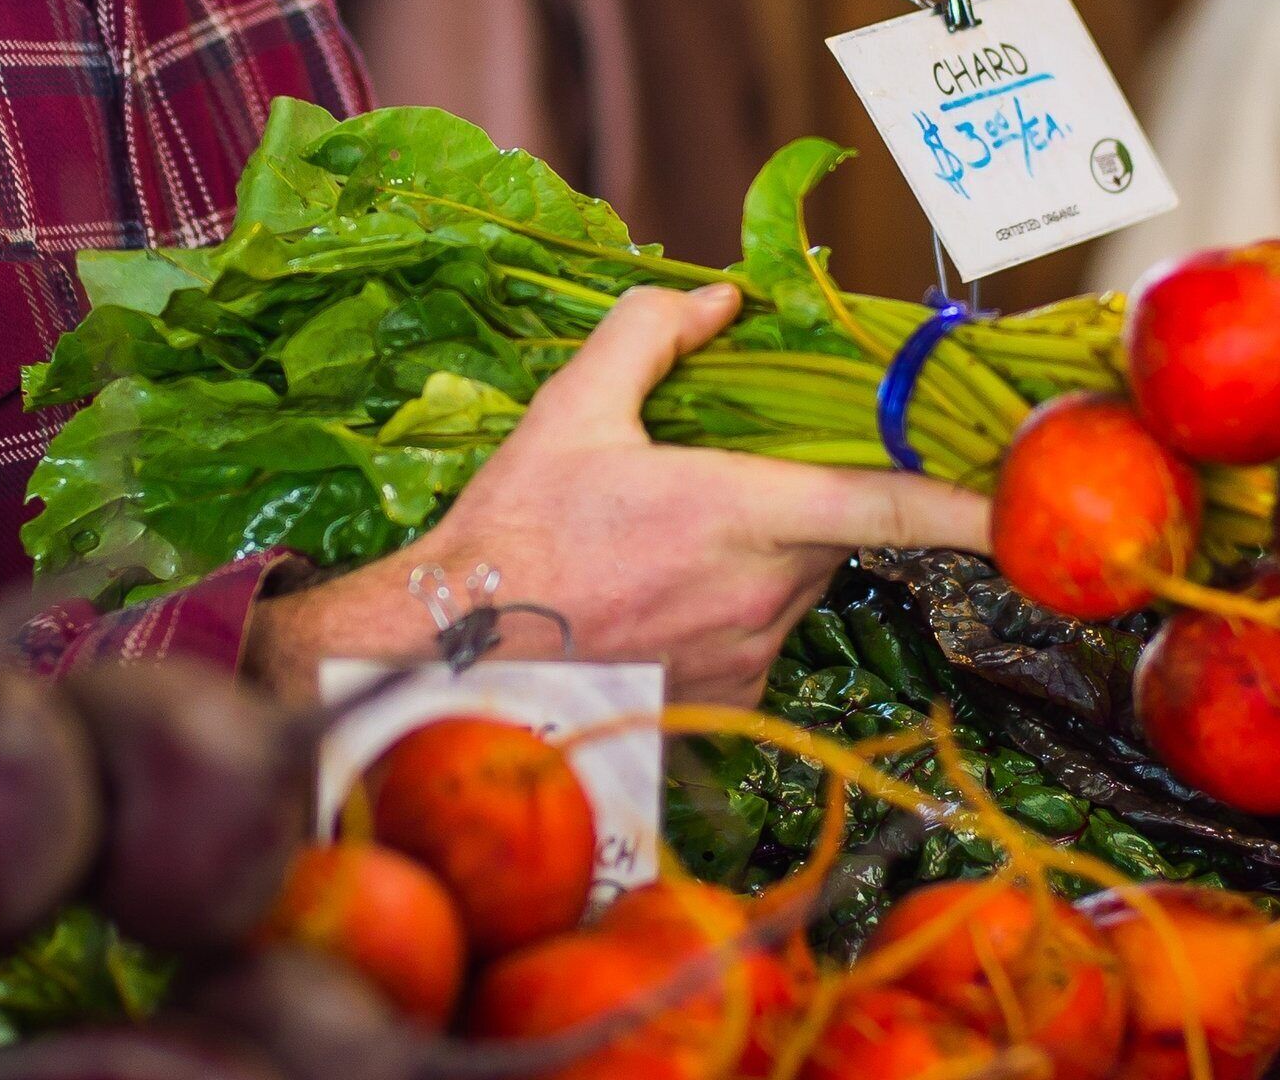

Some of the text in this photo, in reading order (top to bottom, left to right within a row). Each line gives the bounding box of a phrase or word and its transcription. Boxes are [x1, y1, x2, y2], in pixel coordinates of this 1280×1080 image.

[933, 42, 1029, 96] CHARD
[995, 204, 1080, 241] CERTIFIED ORGANIC
